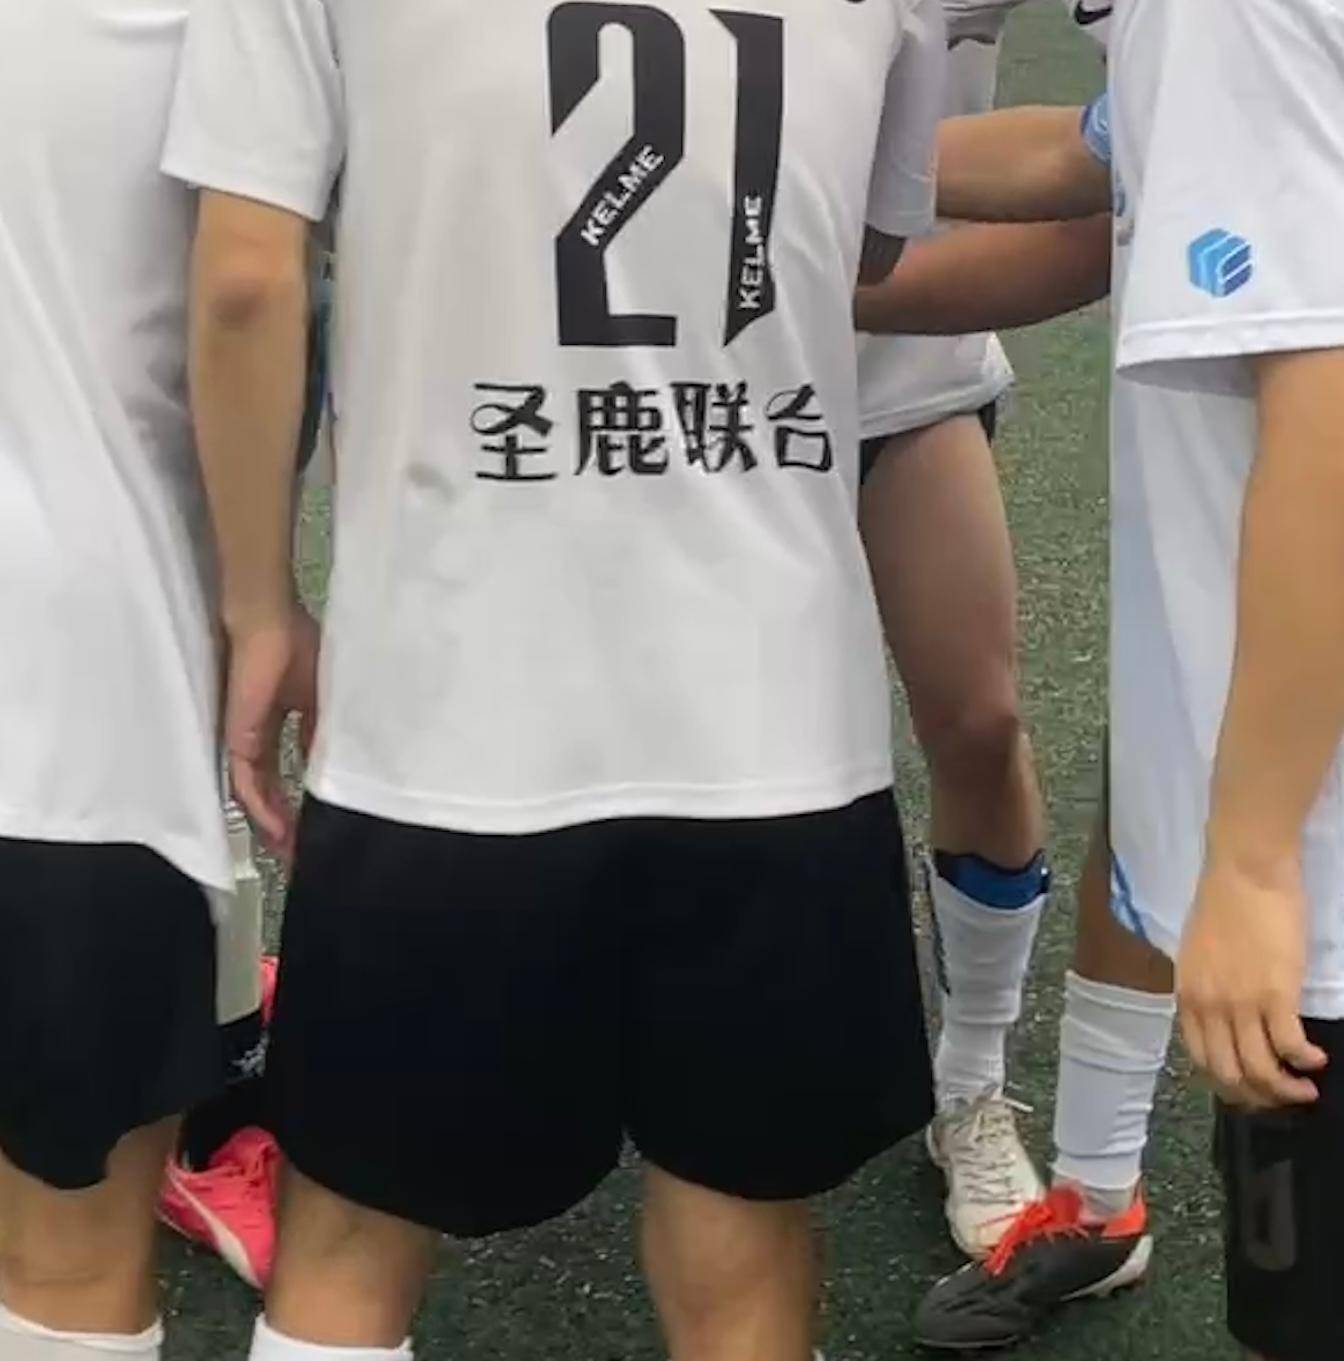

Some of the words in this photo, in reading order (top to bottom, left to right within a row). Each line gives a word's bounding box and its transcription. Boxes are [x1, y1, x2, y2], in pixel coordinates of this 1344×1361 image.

[546, 0, 784, 348] 21
[580, 143, 665, 247] KELME
[736, 194, 766, 310] KELME
